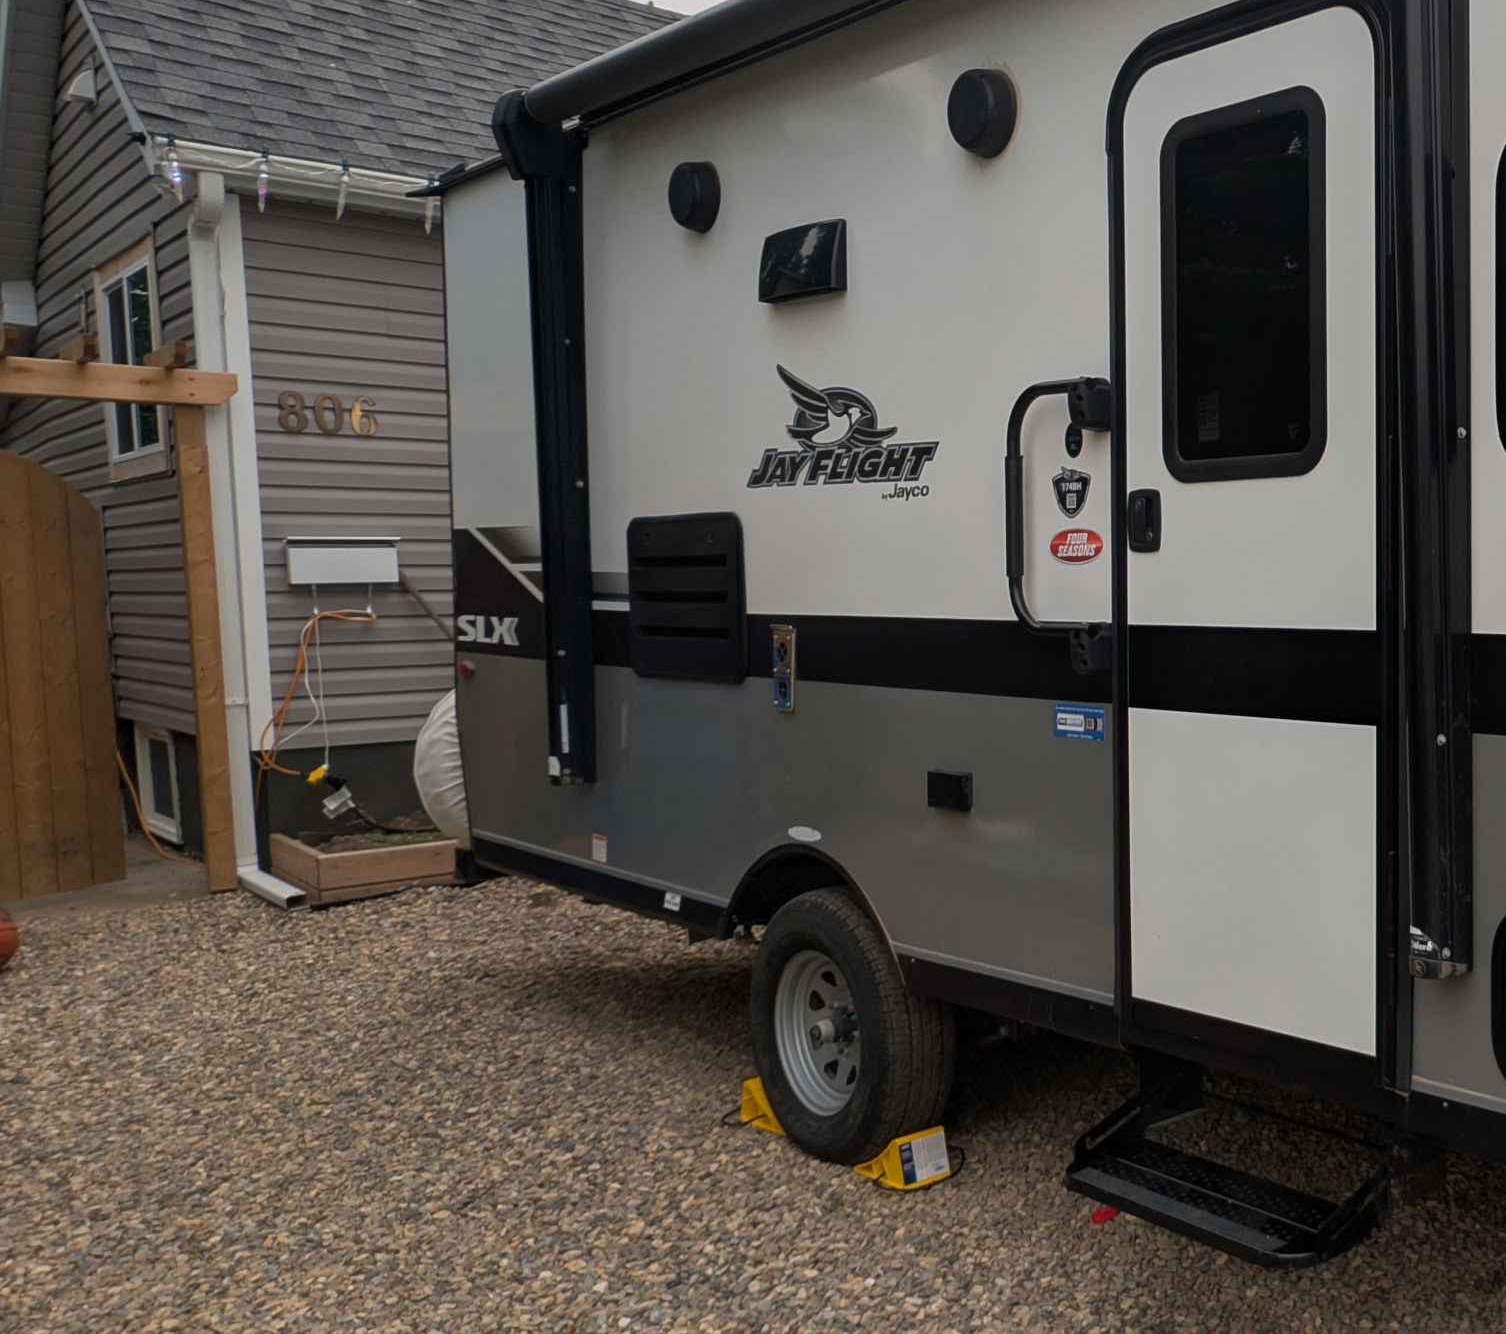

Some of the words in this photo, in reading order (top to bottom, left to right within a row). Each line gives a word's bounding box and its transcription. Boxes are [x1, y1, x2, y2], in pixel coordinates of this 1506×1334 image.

[278, 391, 379, 436] 806
[747, 448, 814, 489] JAY
[804, 441, 940, 486] FLIGHT
[889, 483, 930, 501] Jayco
[1061, 481, 1082, 492] 174BH
[1065, 532, 1088, 546] FOUR
[1057, 543, 1096, 557] SEASONS
[458, 614, 520, 646] SLX
